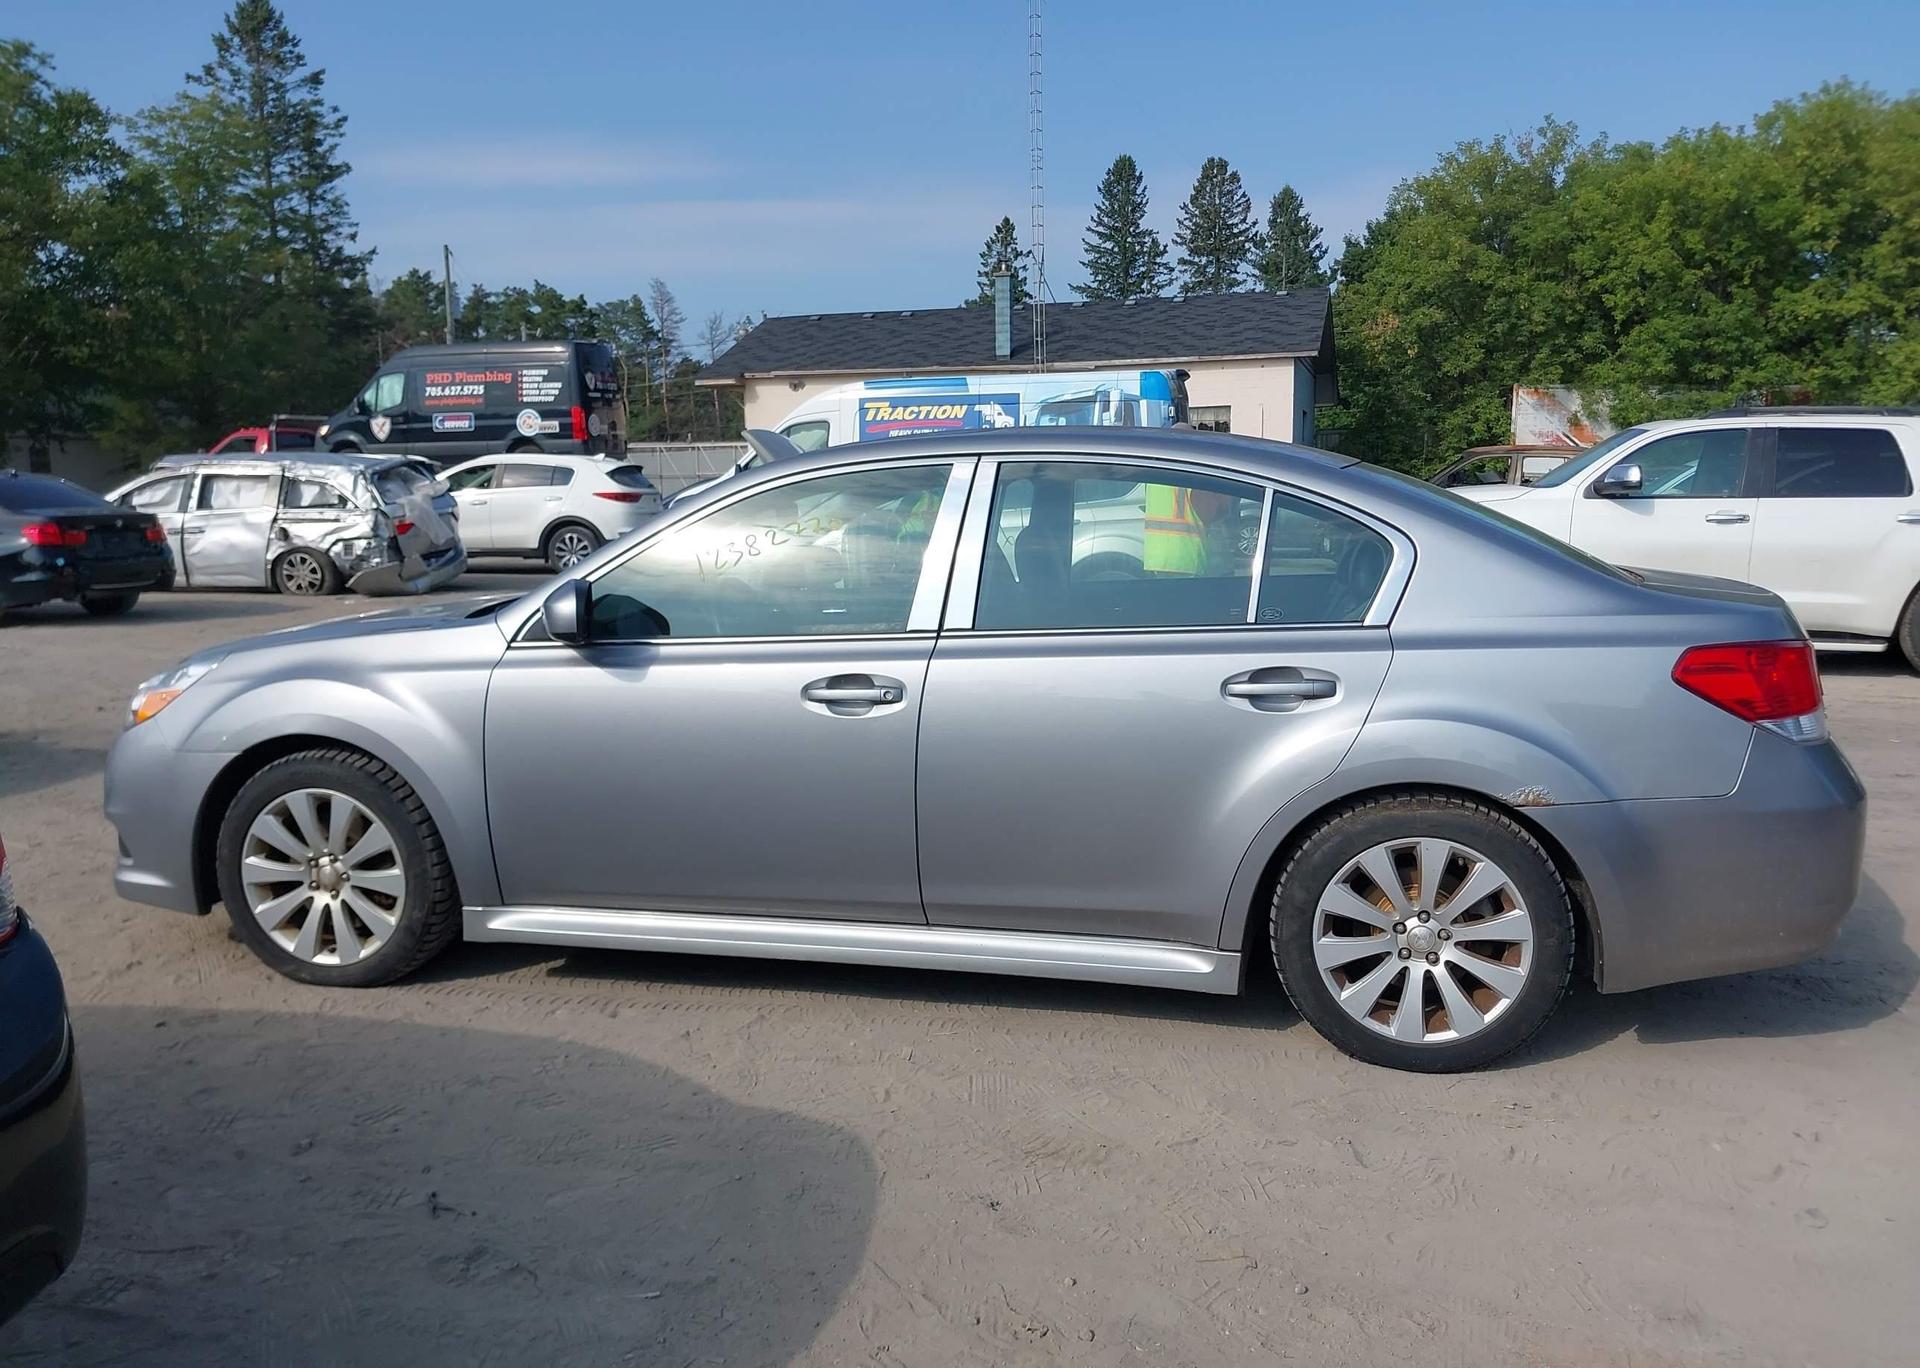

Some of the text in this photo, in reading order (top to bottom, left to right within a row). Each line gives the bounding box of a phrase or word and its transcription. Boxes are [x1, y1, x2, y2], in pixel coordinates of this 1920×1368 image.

[426, 371, 513, 384] PHD Plumbing
[425, 385, 485, 397] 705.627.5725
[864, 402, 968, 421] TRACTION
